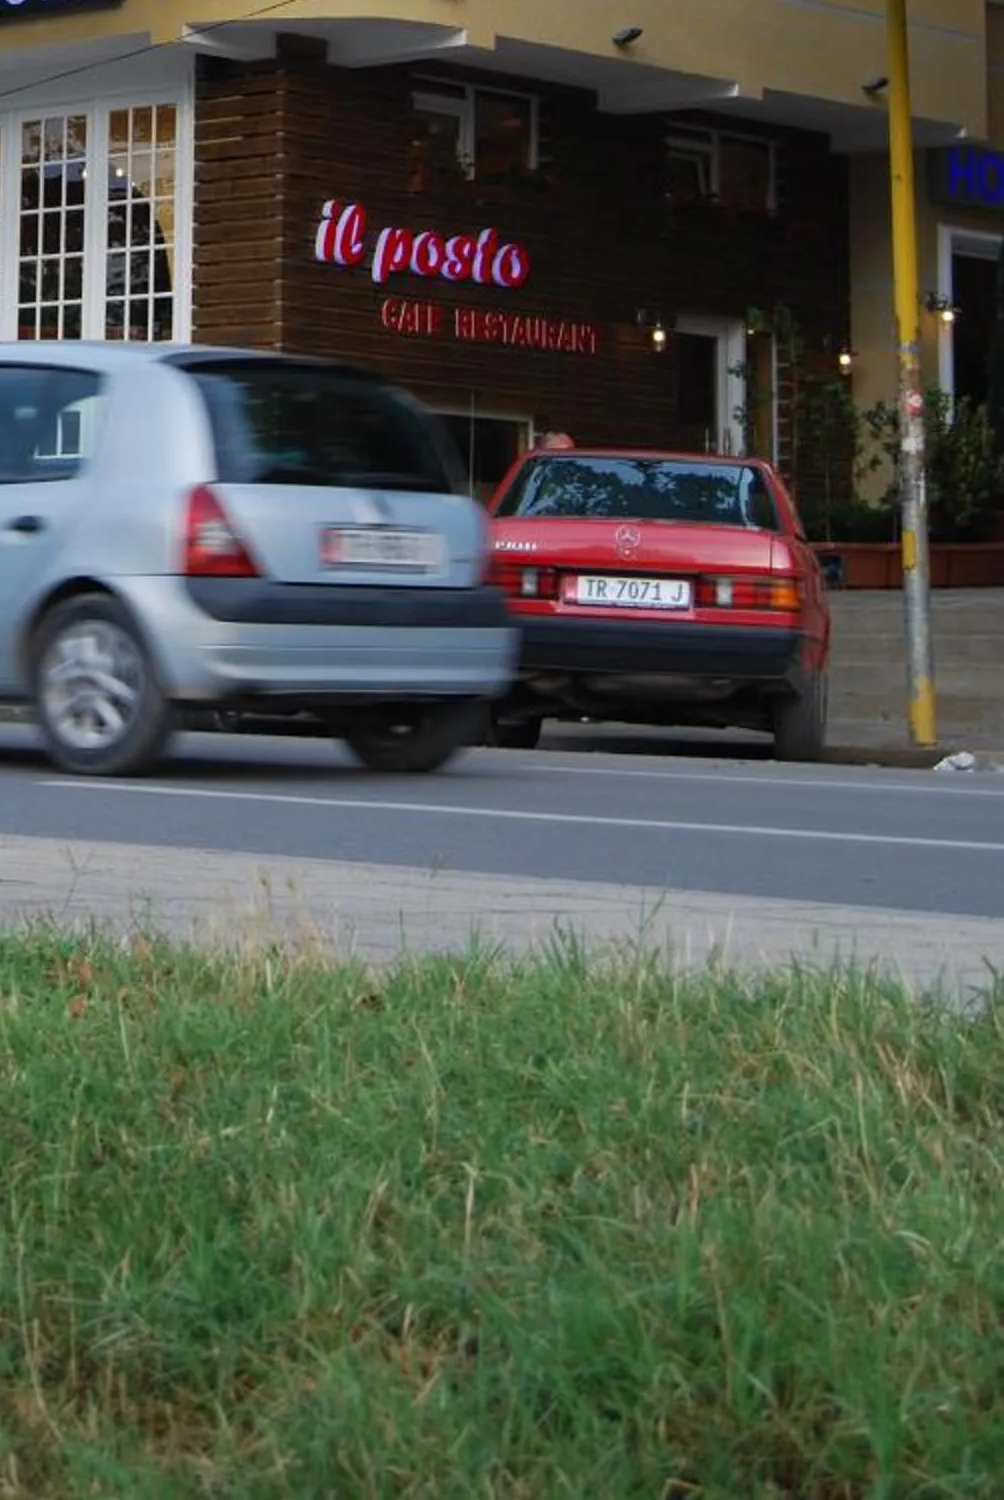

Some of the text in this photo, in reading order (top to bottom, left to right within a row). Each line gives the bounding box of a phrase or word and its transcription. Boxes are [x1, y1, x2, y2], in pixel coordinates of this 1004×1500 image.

[314, 199, 532, 288] il posto
[454, 307, 600, 355] RESTAURANT
[585, 578, 684, 603] TR 7071 J
